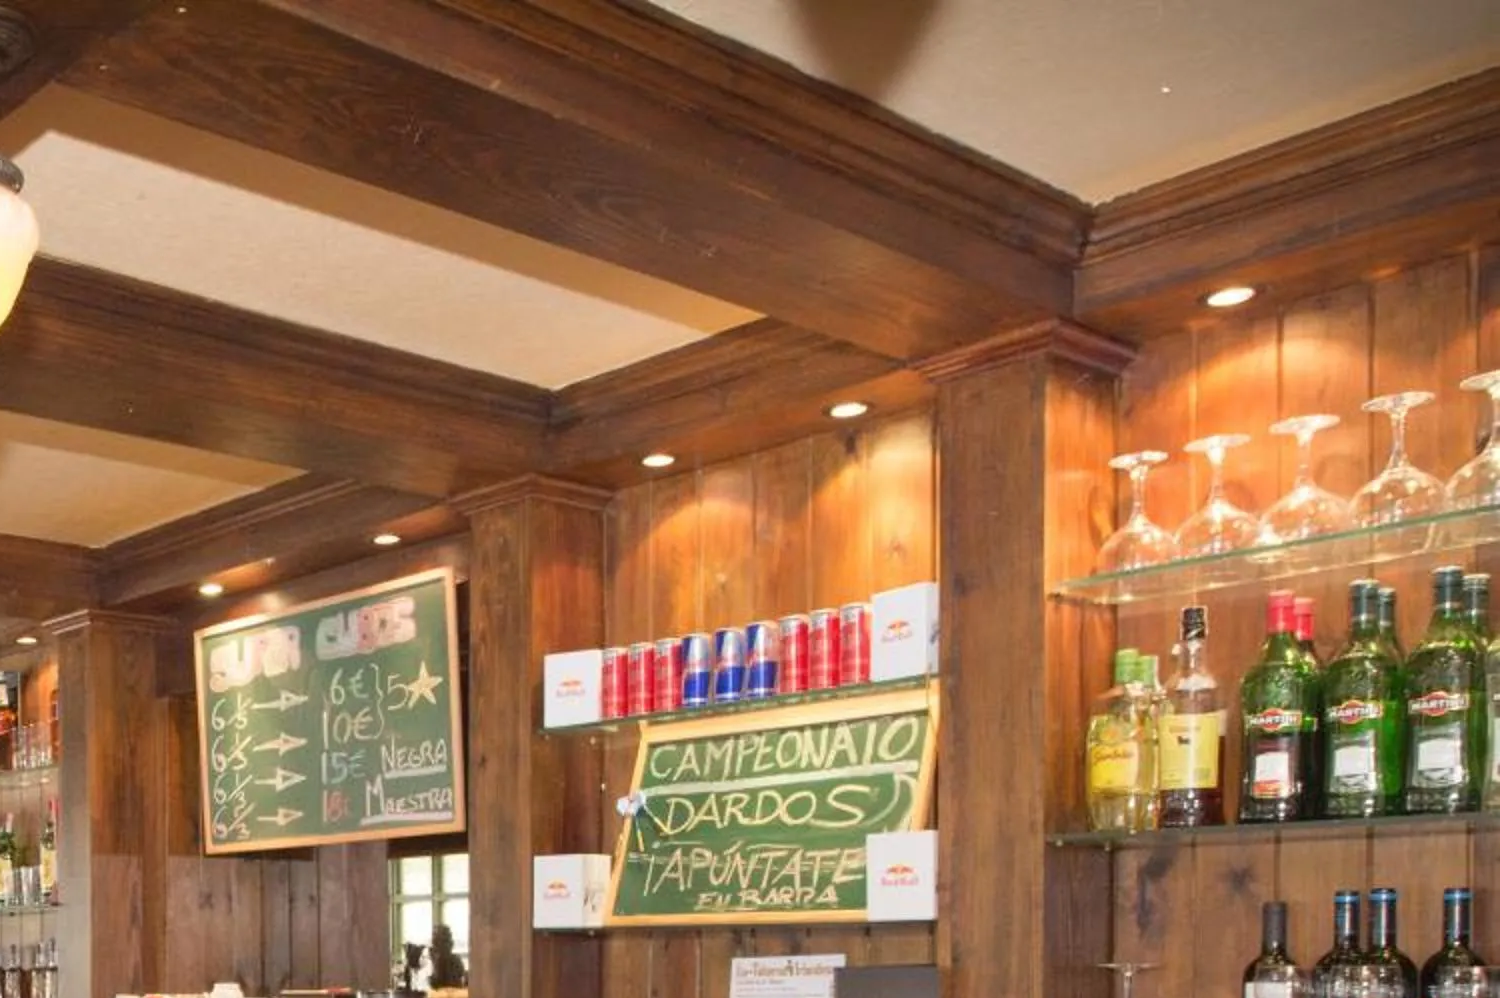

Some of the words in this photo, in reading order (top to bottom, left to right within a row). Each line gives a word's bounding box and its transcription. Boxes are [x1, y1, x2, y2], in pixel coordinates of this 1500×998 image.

[211, 698, 226, 730] 6
[330, 668, 369, 705] 6€
[323, 706, 374, 750] 10€
[321, 751, 367, 785] 15€
[381, 733, 448, 772] NEGRA
[365, 774, 453, 817] MAESTRA
[660, 784, 872, 836] DARDOS
[737, 885, 840, 909] BARRA
